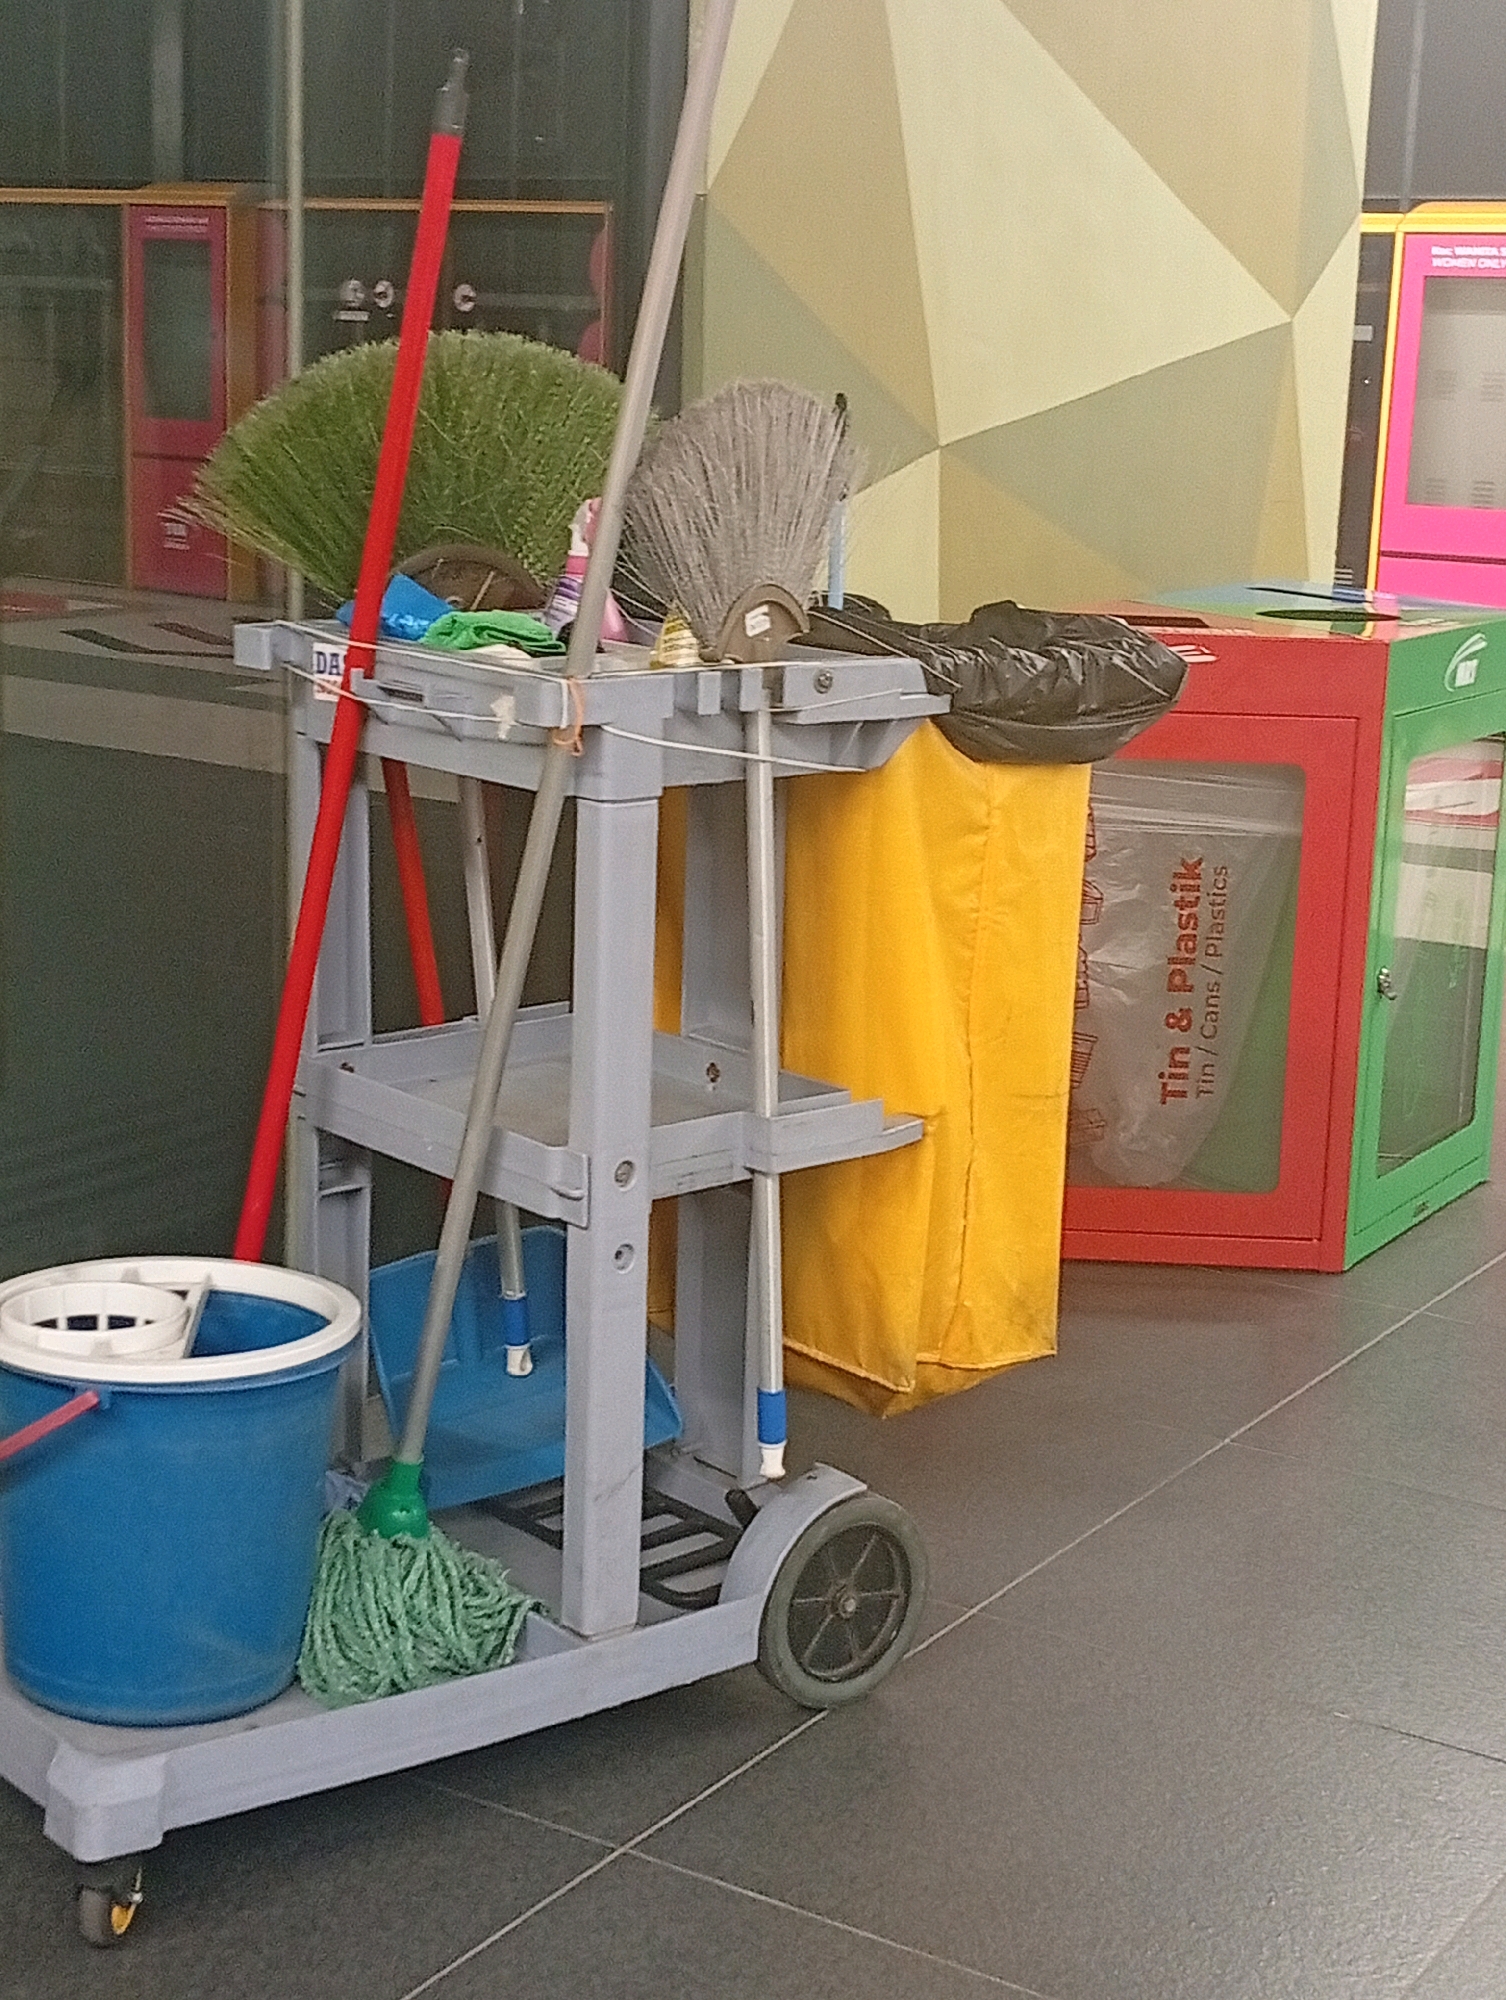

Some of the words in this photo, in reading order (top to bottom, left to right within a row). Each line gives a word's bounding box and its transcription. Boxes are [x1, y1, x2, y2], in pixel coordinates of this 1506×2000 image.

[1432, 257, 1477, 268] WOMEN
[316, 651, 347, 676] DA
[1166, 856, 1205, 994] Plastik
[1204, 865, 1229, 959] Plastics
[1164, 1007, 1193, 1033] &
[1200, 981, 1222, 1041] Cans
[1159, 1045, 1190, 1105] Tin
[1196, 1059, 1216, 1100] Tin
